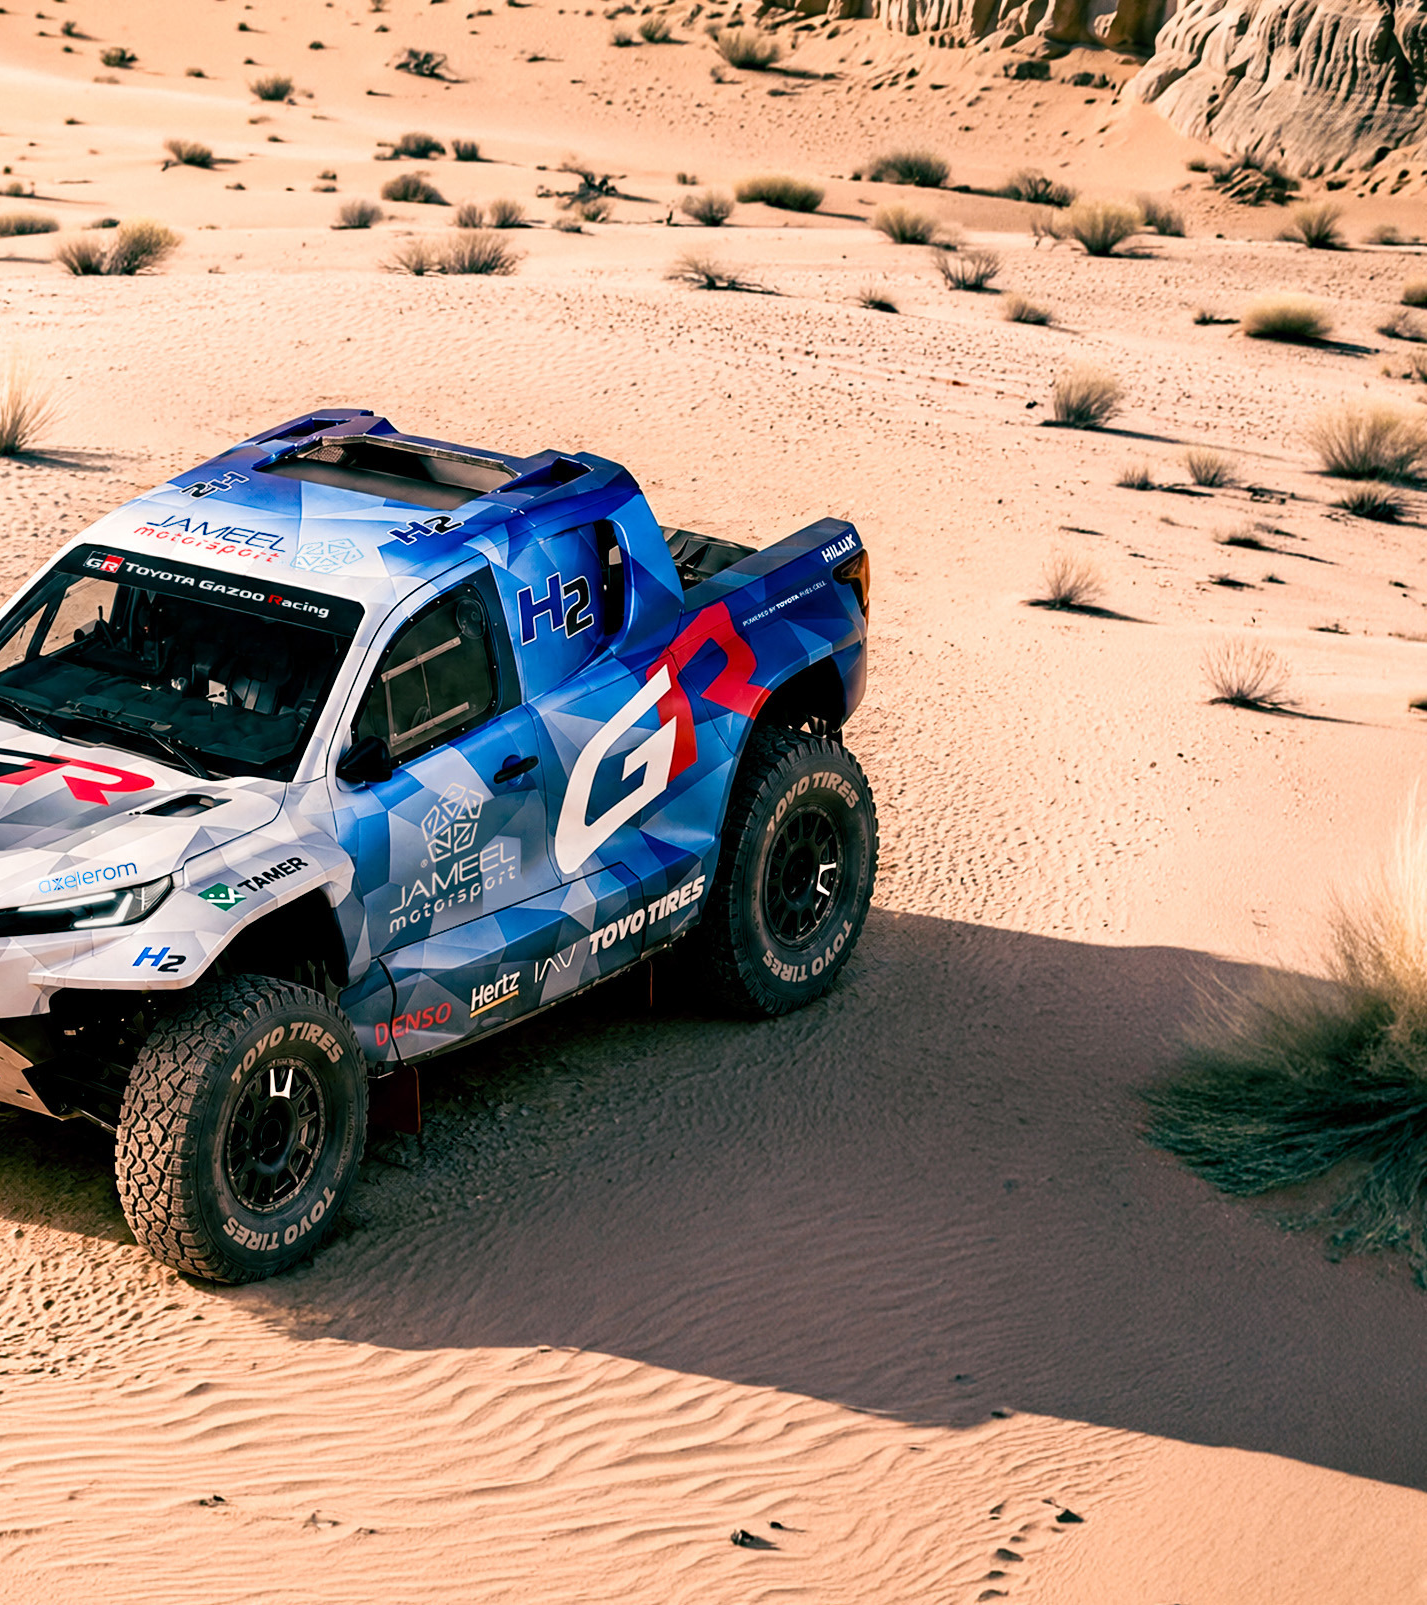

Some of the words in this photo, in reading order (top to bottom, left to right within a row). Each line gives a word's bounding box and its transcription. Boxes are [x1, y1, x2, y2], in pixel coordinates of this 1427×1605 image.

[134, 526, 281, 564] motorsport
[146, 515, 286, 553] JAMEEL
[387, 514, 464, 546] H2
[821, 533, 857, 563] HILUX
[85, 556, 123, 573] GR
[125, 562, 195, 586] TOYOTA
[198, 580, 265, 602] GAZOO
[268, 594, 330, 619] Racing
[517, 572, 595, 646] H2
[775, 594, 800, 609] TOYOTA
[555, 601, 772, 875] GR
[766, 775, 810, 833] TOYO
[812, 771, 860, 809] TIRES
[38, 862, 138, 894] axelerom
[237, 857, 309, 893] TAMER
[389, 842, 516, 914] JAMEEL
[389, 865, 517, 934] motorsport
[589, 908, 646, 956] TOYO
[646, 875, 705, 926] TIRES
[132, 946, 187, 973] H2
[762, 949, 810, 983] TIRES
[811, 919, 854, 976] TOYO
[471, 969, 520, 1011] Hertz
[375, 1002, 452, 1047] DENSO
[230, 1026, 285, 1085] TOYO
[288, 1022, 344, 1064] TIRES
[222, 1215, 280, 1251] TIRES
[283, 1186, 336, 1244] TOYO
